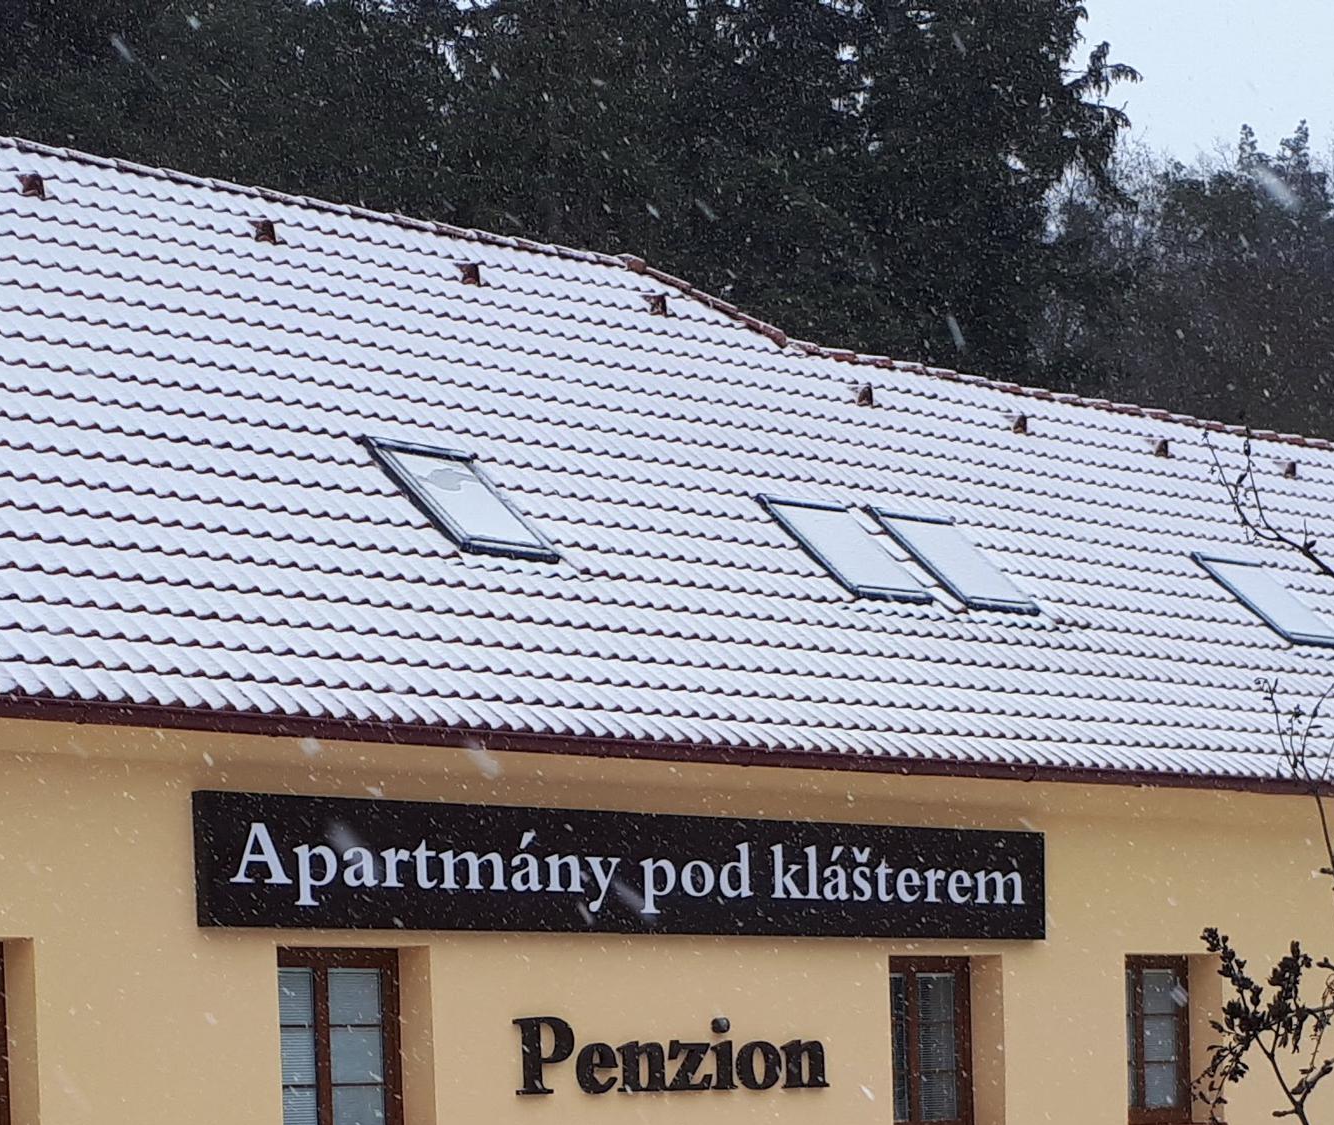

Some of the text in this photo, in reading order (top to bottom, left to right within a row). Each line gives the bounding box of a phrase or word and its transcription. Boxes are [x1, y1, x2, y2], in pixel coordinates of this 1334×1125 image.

[228, 821, 1026, 914] Apartmány pod klášterem
[511, 1015, 831, 1096] Penzion
